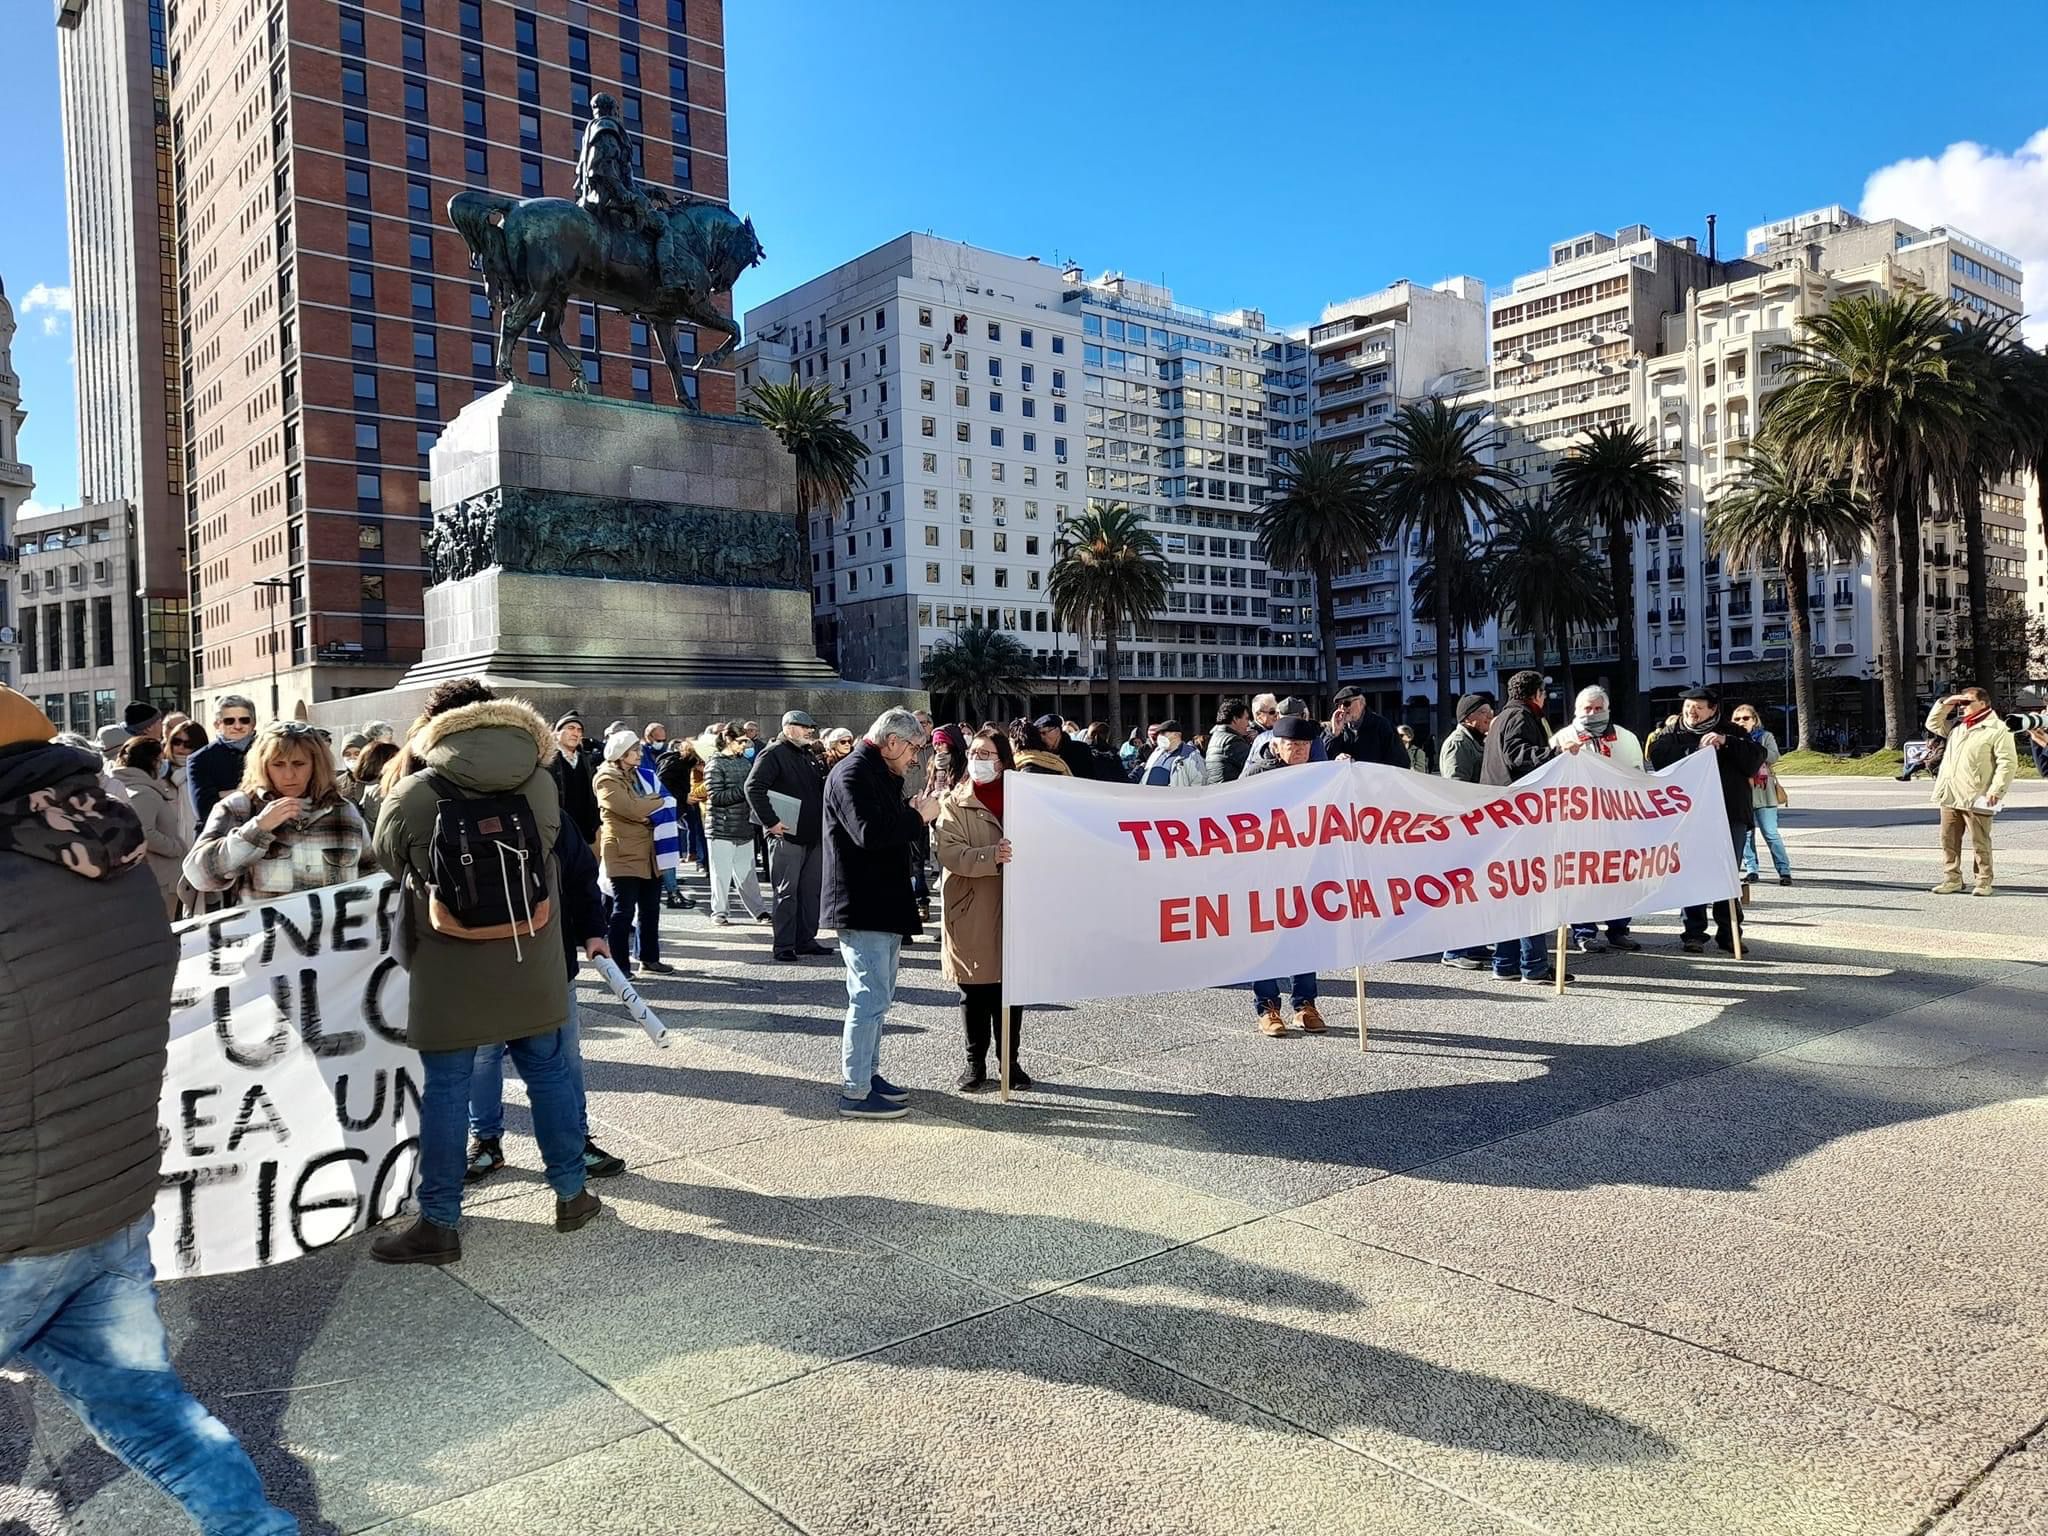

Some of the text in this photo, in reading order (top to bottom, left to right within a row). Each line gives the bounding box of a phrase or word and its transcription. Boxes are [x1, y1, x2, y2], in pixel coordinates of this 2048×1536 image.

[1458, 785, 1693, 836] PROFESIONALES
[1159, 842, 1681, 943] EN LUCHA POR SUS DERECHOS
[158, 1084, 291, 1157] EA
